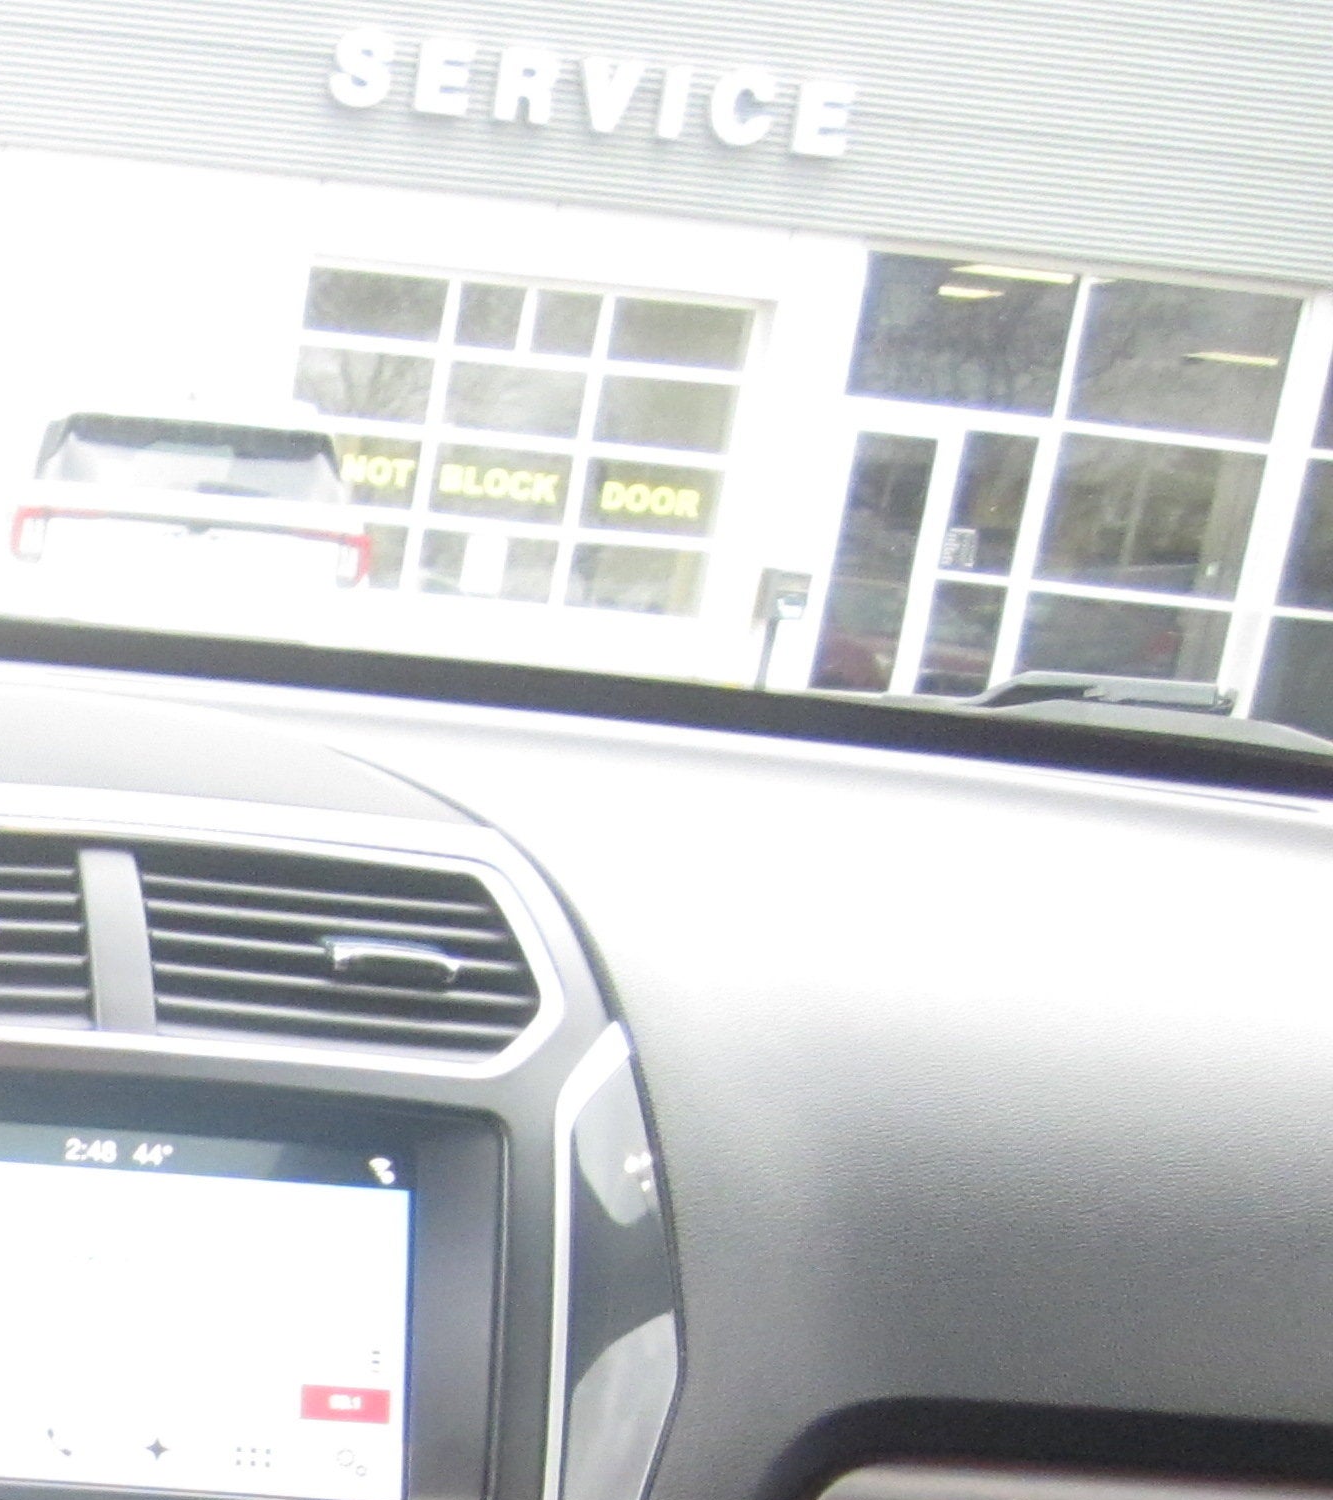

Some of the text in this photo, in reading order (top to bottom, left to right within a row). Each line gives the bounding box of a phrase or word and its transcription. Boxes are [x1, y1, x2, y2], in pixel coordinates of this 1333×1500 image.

[330, 25, 858, 158] SERVICE
[340, 452, 702, 520] NOT BLOCK DOOR
